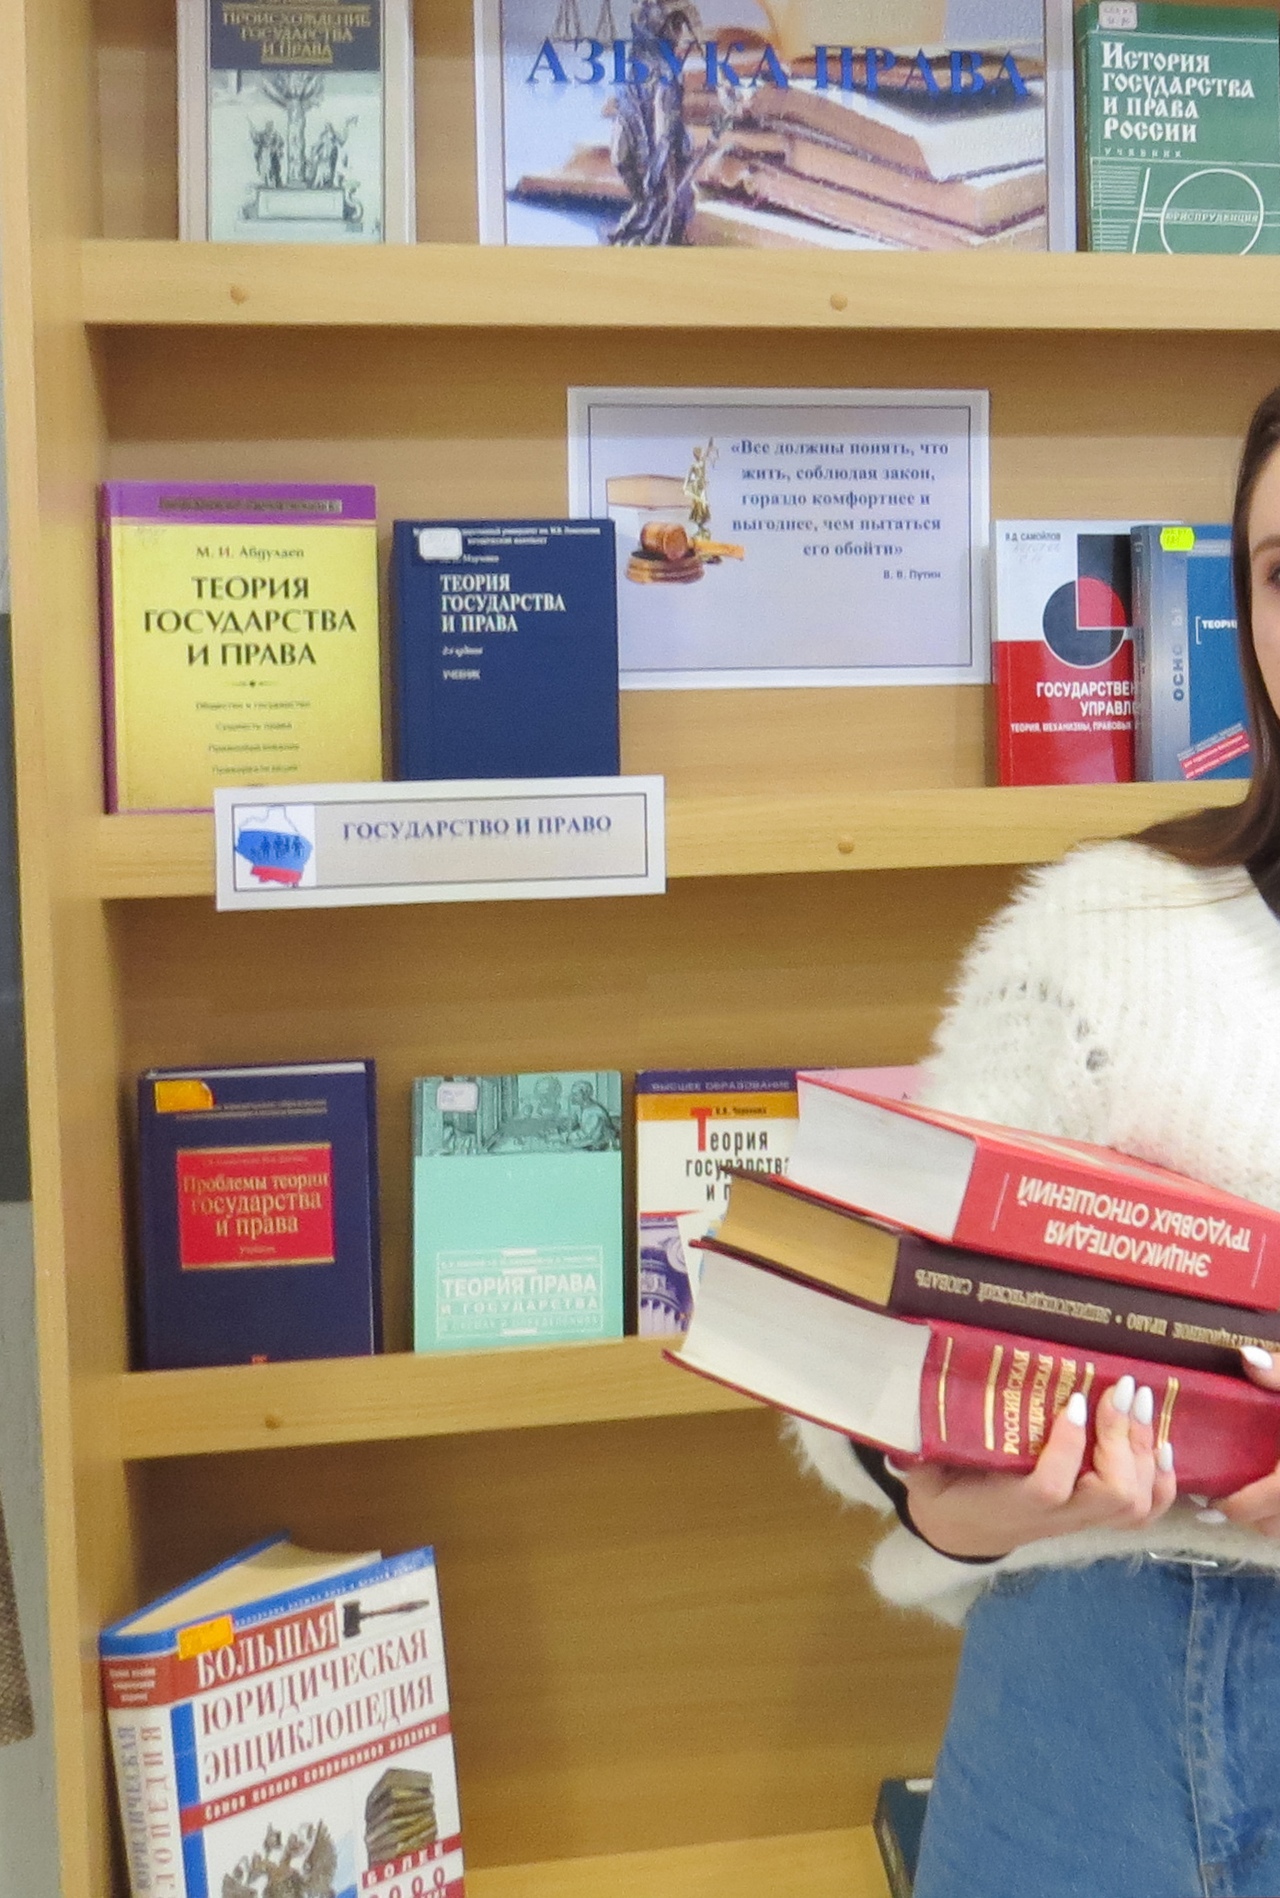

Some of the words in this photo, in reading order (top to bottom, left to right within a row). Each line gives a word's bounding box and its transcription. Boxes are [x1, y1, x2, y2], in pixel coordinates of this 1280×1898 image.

[526, 37, 790, 91] АЗБУКА
[814, 43, 1030, 98] ПРАВА
[731, 440, 771, 455] «Все
[774, 441, 845, 457] должны
[850, 442, 914, 458] понять,
[920, 443, 949, 455] что
[741, 468, 790, 482] жить,
[796, 466, 879, 482] соблюдая
[883, 468, 936, 482] закон,
[742, 493, 807, 508] гораздо
[812, 492, 915, 509] комфортнее
[920, 494, 931, 506] и
[732, 518, 818, 533] выгоднее,
[823, 519, 855, 531] чем
[860, 518, 941, 532] пытаться
[803, 544, 830, 557] его
[835, 542, 904, 557] обойти»
[191, 575, 310, 601] ТЕОРИЯ
[440, 573, 511, 592] ТЕОРИЯ
[909, 570, 941, 582] Путин
[441, 593, 567, 614] ГОСУДАРСТВА
[143, 608, 357, 635] ГОСУДАРСТВА
[441, 614, 456, 633] И
[461, 613, 519, 633] ПРАВА
[187, 644, 210, 667] И
[220, 643, 318, 667] ПРАВА
[1080, 700, 1132, 717] УПРАВЛ
[343, 817, 510, 841] ГОСУДАРСТВО
[516, 816, 530, 834] И
[538, 815, 613, 834] ПРАВО
[690, 1107, 768, 1157] Теория
[183, 1174, 268, 1195] Проблемы
[273, 1172, 329, 1190] теории
[706, 1184, 715, 1201] и
[191, 1191, 322, 1217] государства
[1017, 1175, 1150, 1229] ОТНОШЕНИЙ
[216, 1218, 228, 1237] и
[236, 1216, 299, 1241] права
[1153, 1206, 1252, 1253] ТРУДОВЫХ
[1044, 1219, 1212, 1278] ЭНЦИКЛОПЕДИЯ
[441, 1275, 525, 1298] ТЕОРИЯ
[530, 1273, 597, 1295] ПРАВА
[914, 1268, 973, 1295] СЛОВАРЬ
[463, 1298, 598, 1315] ГОСУДАРСТВА
[1127, 1313, 1168, 1337] ПРАВО
[1002, 1347, 1030, 1456] РОССИЙСКАЯ
[196, 1609, 339, 1689] БОЛЬШАЯ
[202, 1628, 429, 1735] ЮРИДИЧЕСКАЯ
[204, 1673, 435, 1786] ЭНЦИКЛОПЕДИЯ
[140, 1726, 178, 1898] ЛОПЕДИЯ
[368, 1867, 446, 1898] 000
